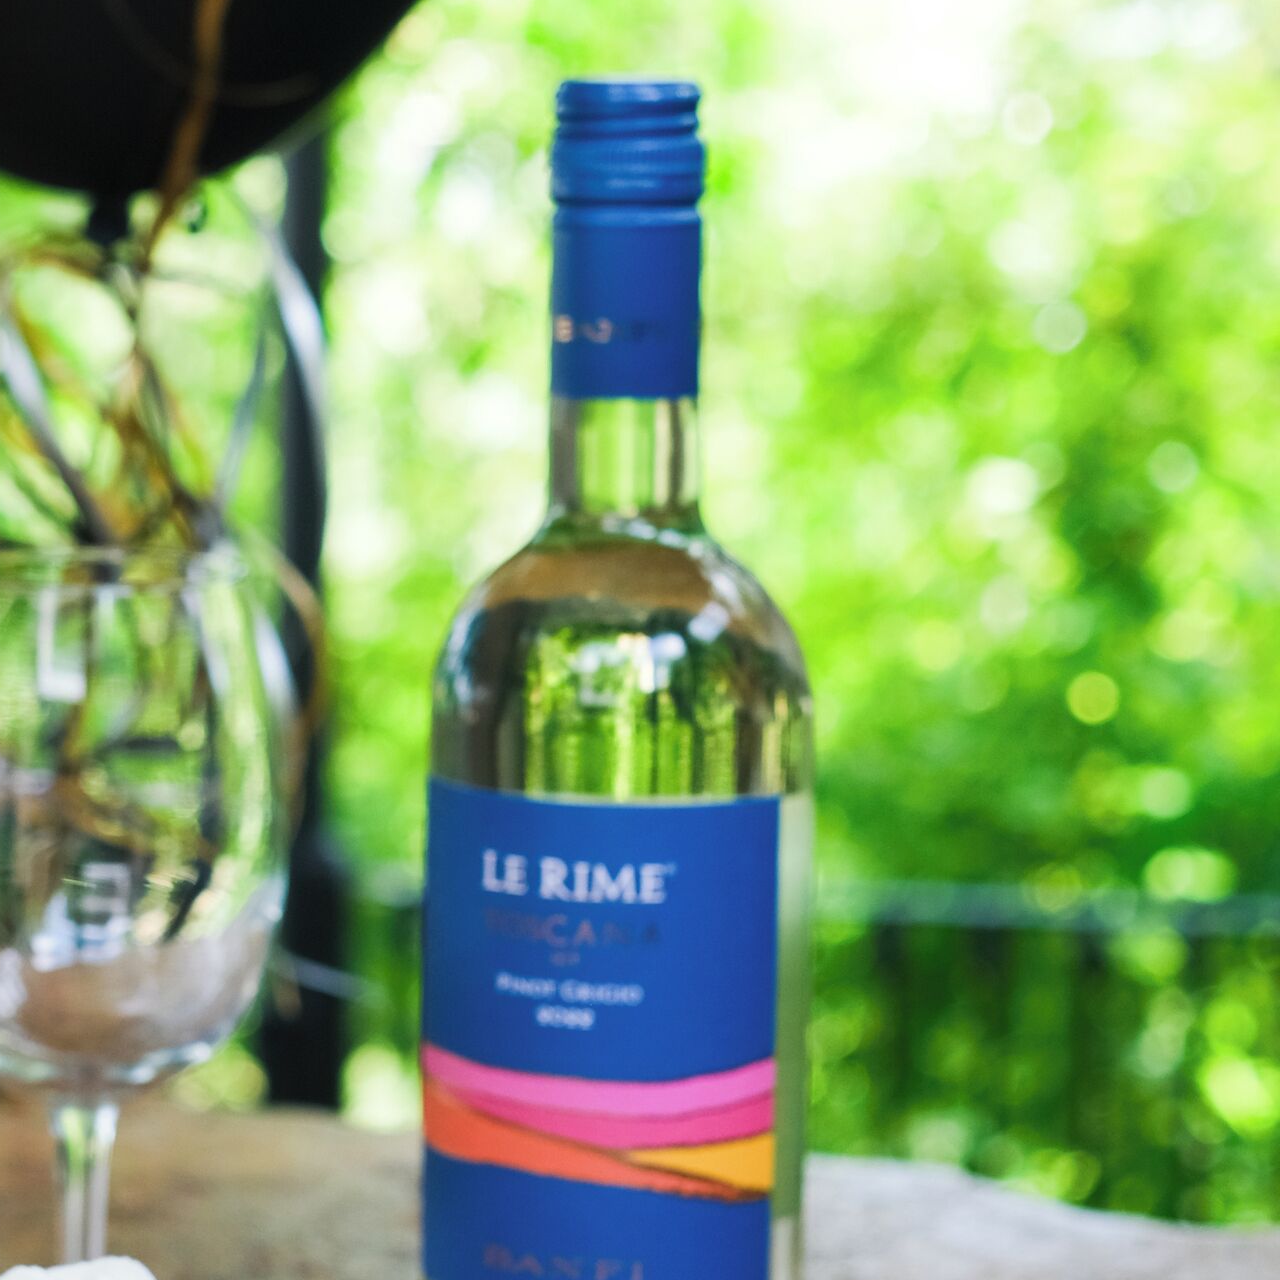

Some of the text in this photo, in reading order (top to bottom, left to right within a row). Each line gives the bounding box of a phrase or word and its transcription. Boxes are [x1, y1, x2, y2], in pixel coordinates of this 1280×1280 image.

[482, 849, 666, 904] LE RIME
[484, 908, 660, 948] CANA
